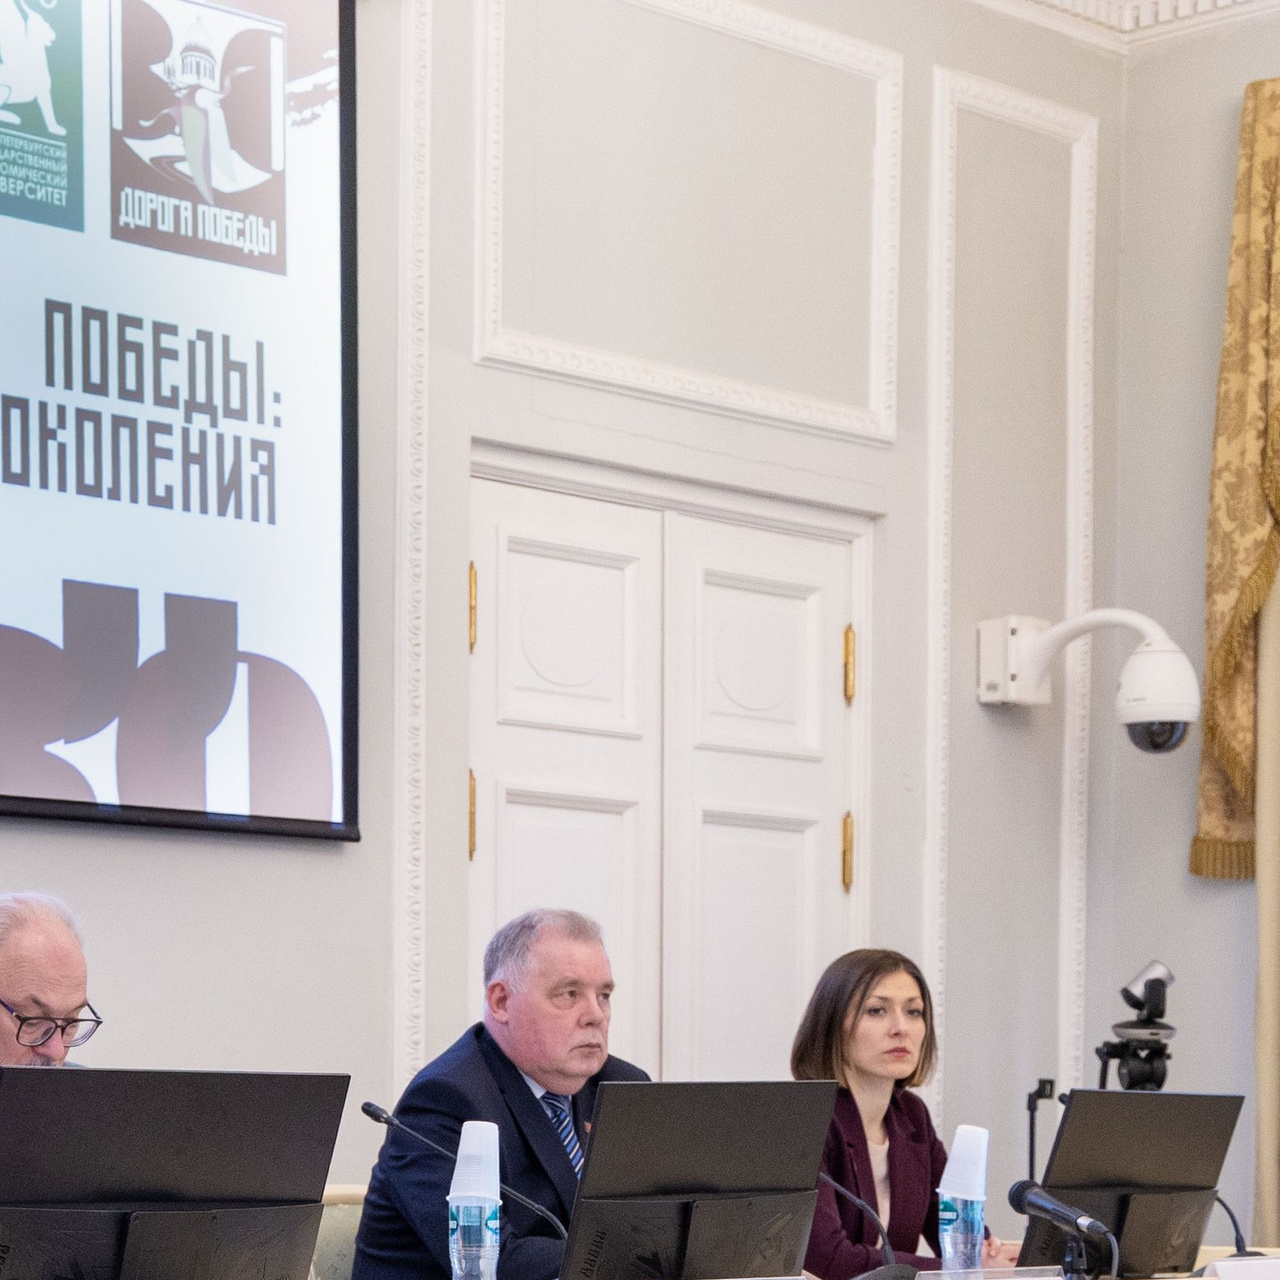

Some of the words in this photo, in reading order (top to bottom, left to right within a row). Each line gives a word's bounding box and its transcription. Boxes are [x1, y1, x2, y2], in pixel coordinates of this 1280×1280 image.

[119, 187, 193, 237] ДОРОГА
[197, 203, 277, 257] ПОБЕДЫ
[44, 298, 283, 429] ПОБЕДЫ:
